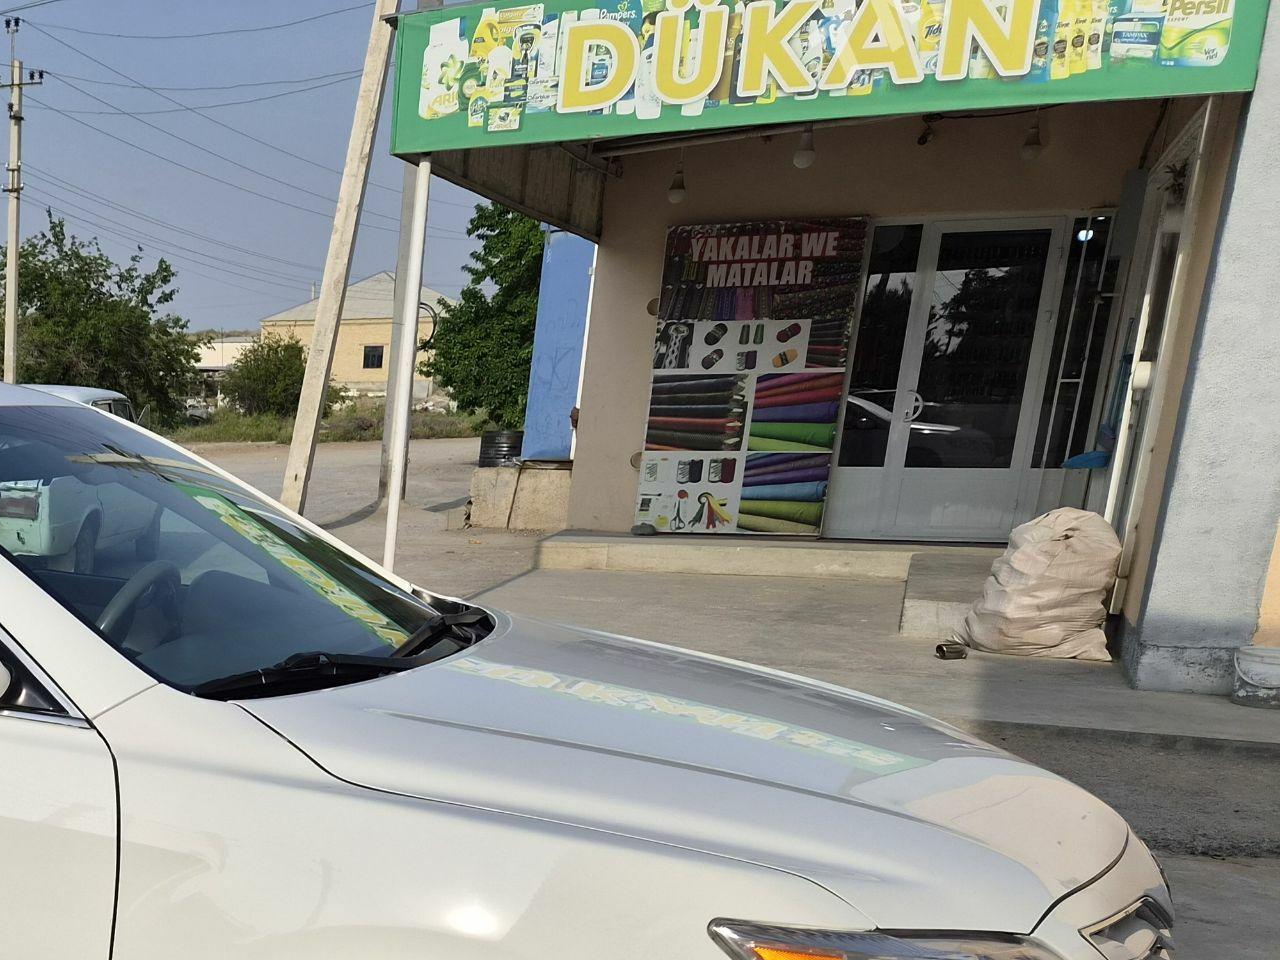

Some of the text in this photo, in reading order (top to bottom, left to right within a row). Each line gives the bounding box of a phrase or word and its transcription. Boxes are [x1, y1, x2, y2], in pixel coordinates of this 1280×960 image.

[557, 0, 1043, 114] DÜKAN
[691, 231, 839, 261] YAKALAR WE
[706, 261, 813, 287] MATALAR
